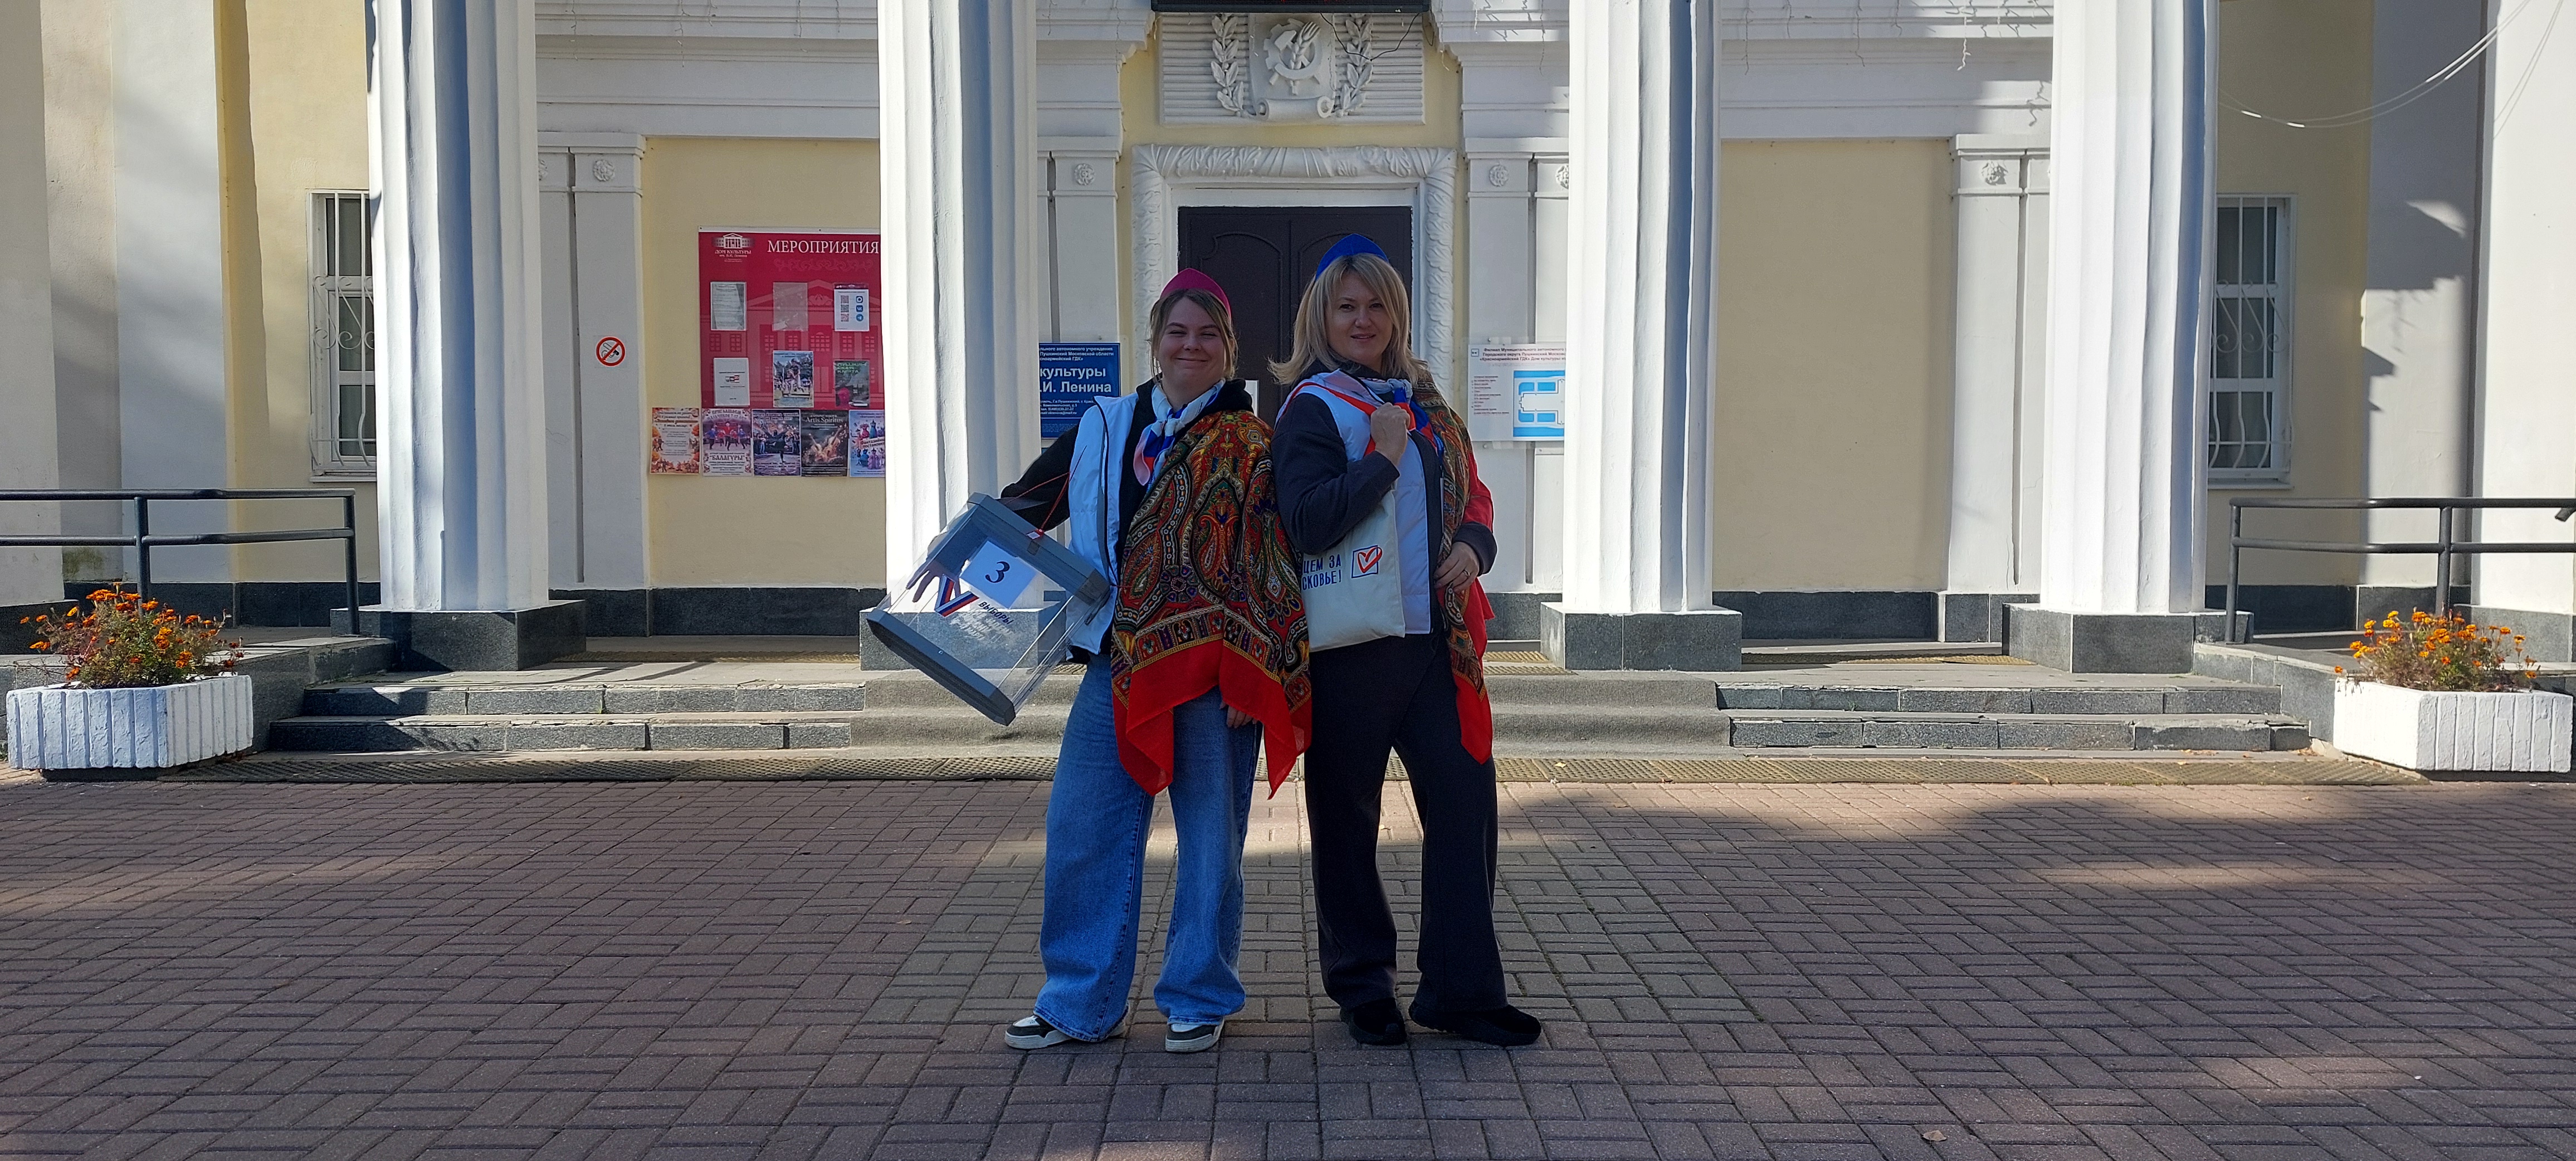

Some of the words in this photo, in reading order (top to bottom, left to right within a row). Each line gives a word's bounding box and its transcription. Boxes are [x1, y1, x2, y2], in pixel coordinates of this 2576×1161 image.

[767, 240, 879, 254] МЕРОПРИЯТИЯ
[1040, 368, 1106, 379] культуры
[1060, 381, 1111, 392] Ленина
[985, 561, 1010, 583] 3
[1303, 557, 1324, 574] ЦЕМ
[1329, 554, 1341, 569] ЗА
[1302, 569, 1342, 591] СКОВЬЕ!
[977, 601, 1014, 625] ВЫБОРЫ
